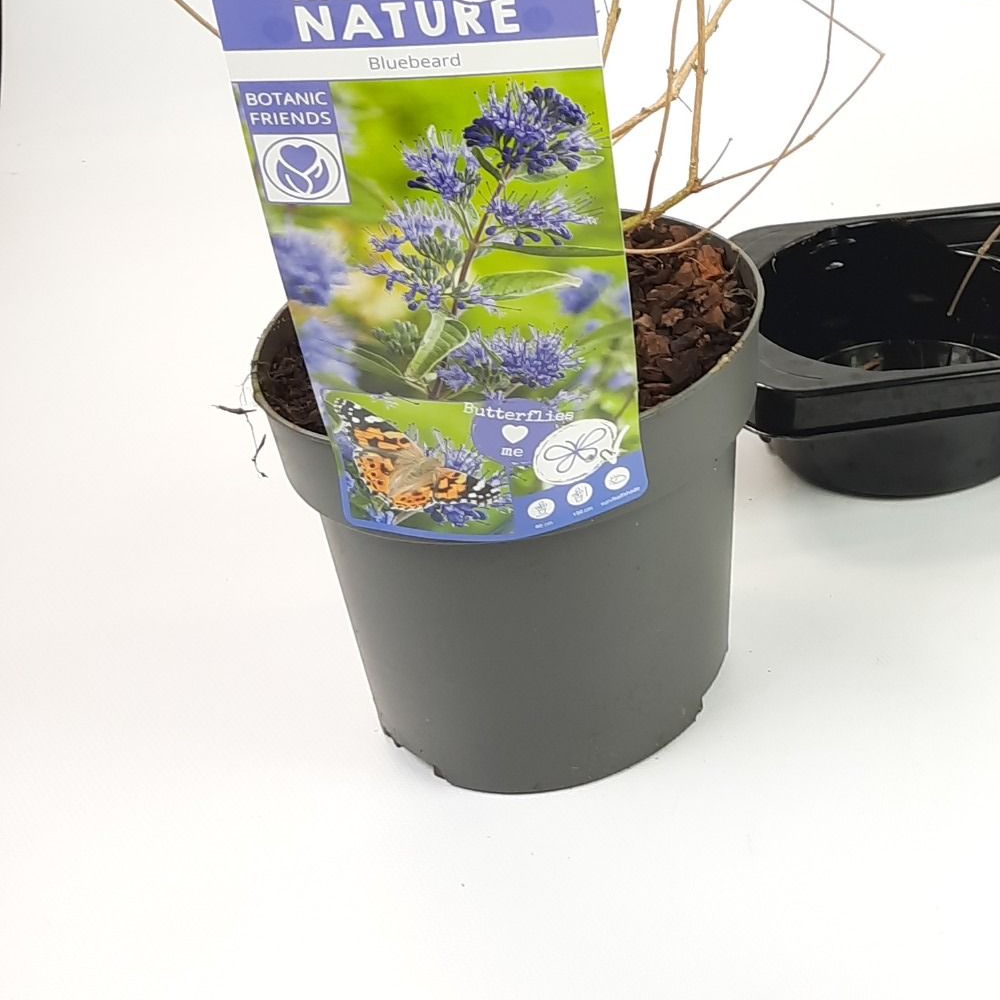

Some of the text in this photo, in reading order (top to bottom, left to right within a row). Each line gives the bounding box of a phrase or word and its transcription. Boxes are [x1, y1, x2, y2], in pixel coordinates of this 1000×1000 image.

[368, 53, 461, 71] Bluebeard
[245, 91, 327, 107] BOTANIC
[250, 111, 331, 126] FRIENDS
[464, 402, 574, 422] Butterflies
[501, 446, 523, 458] me
